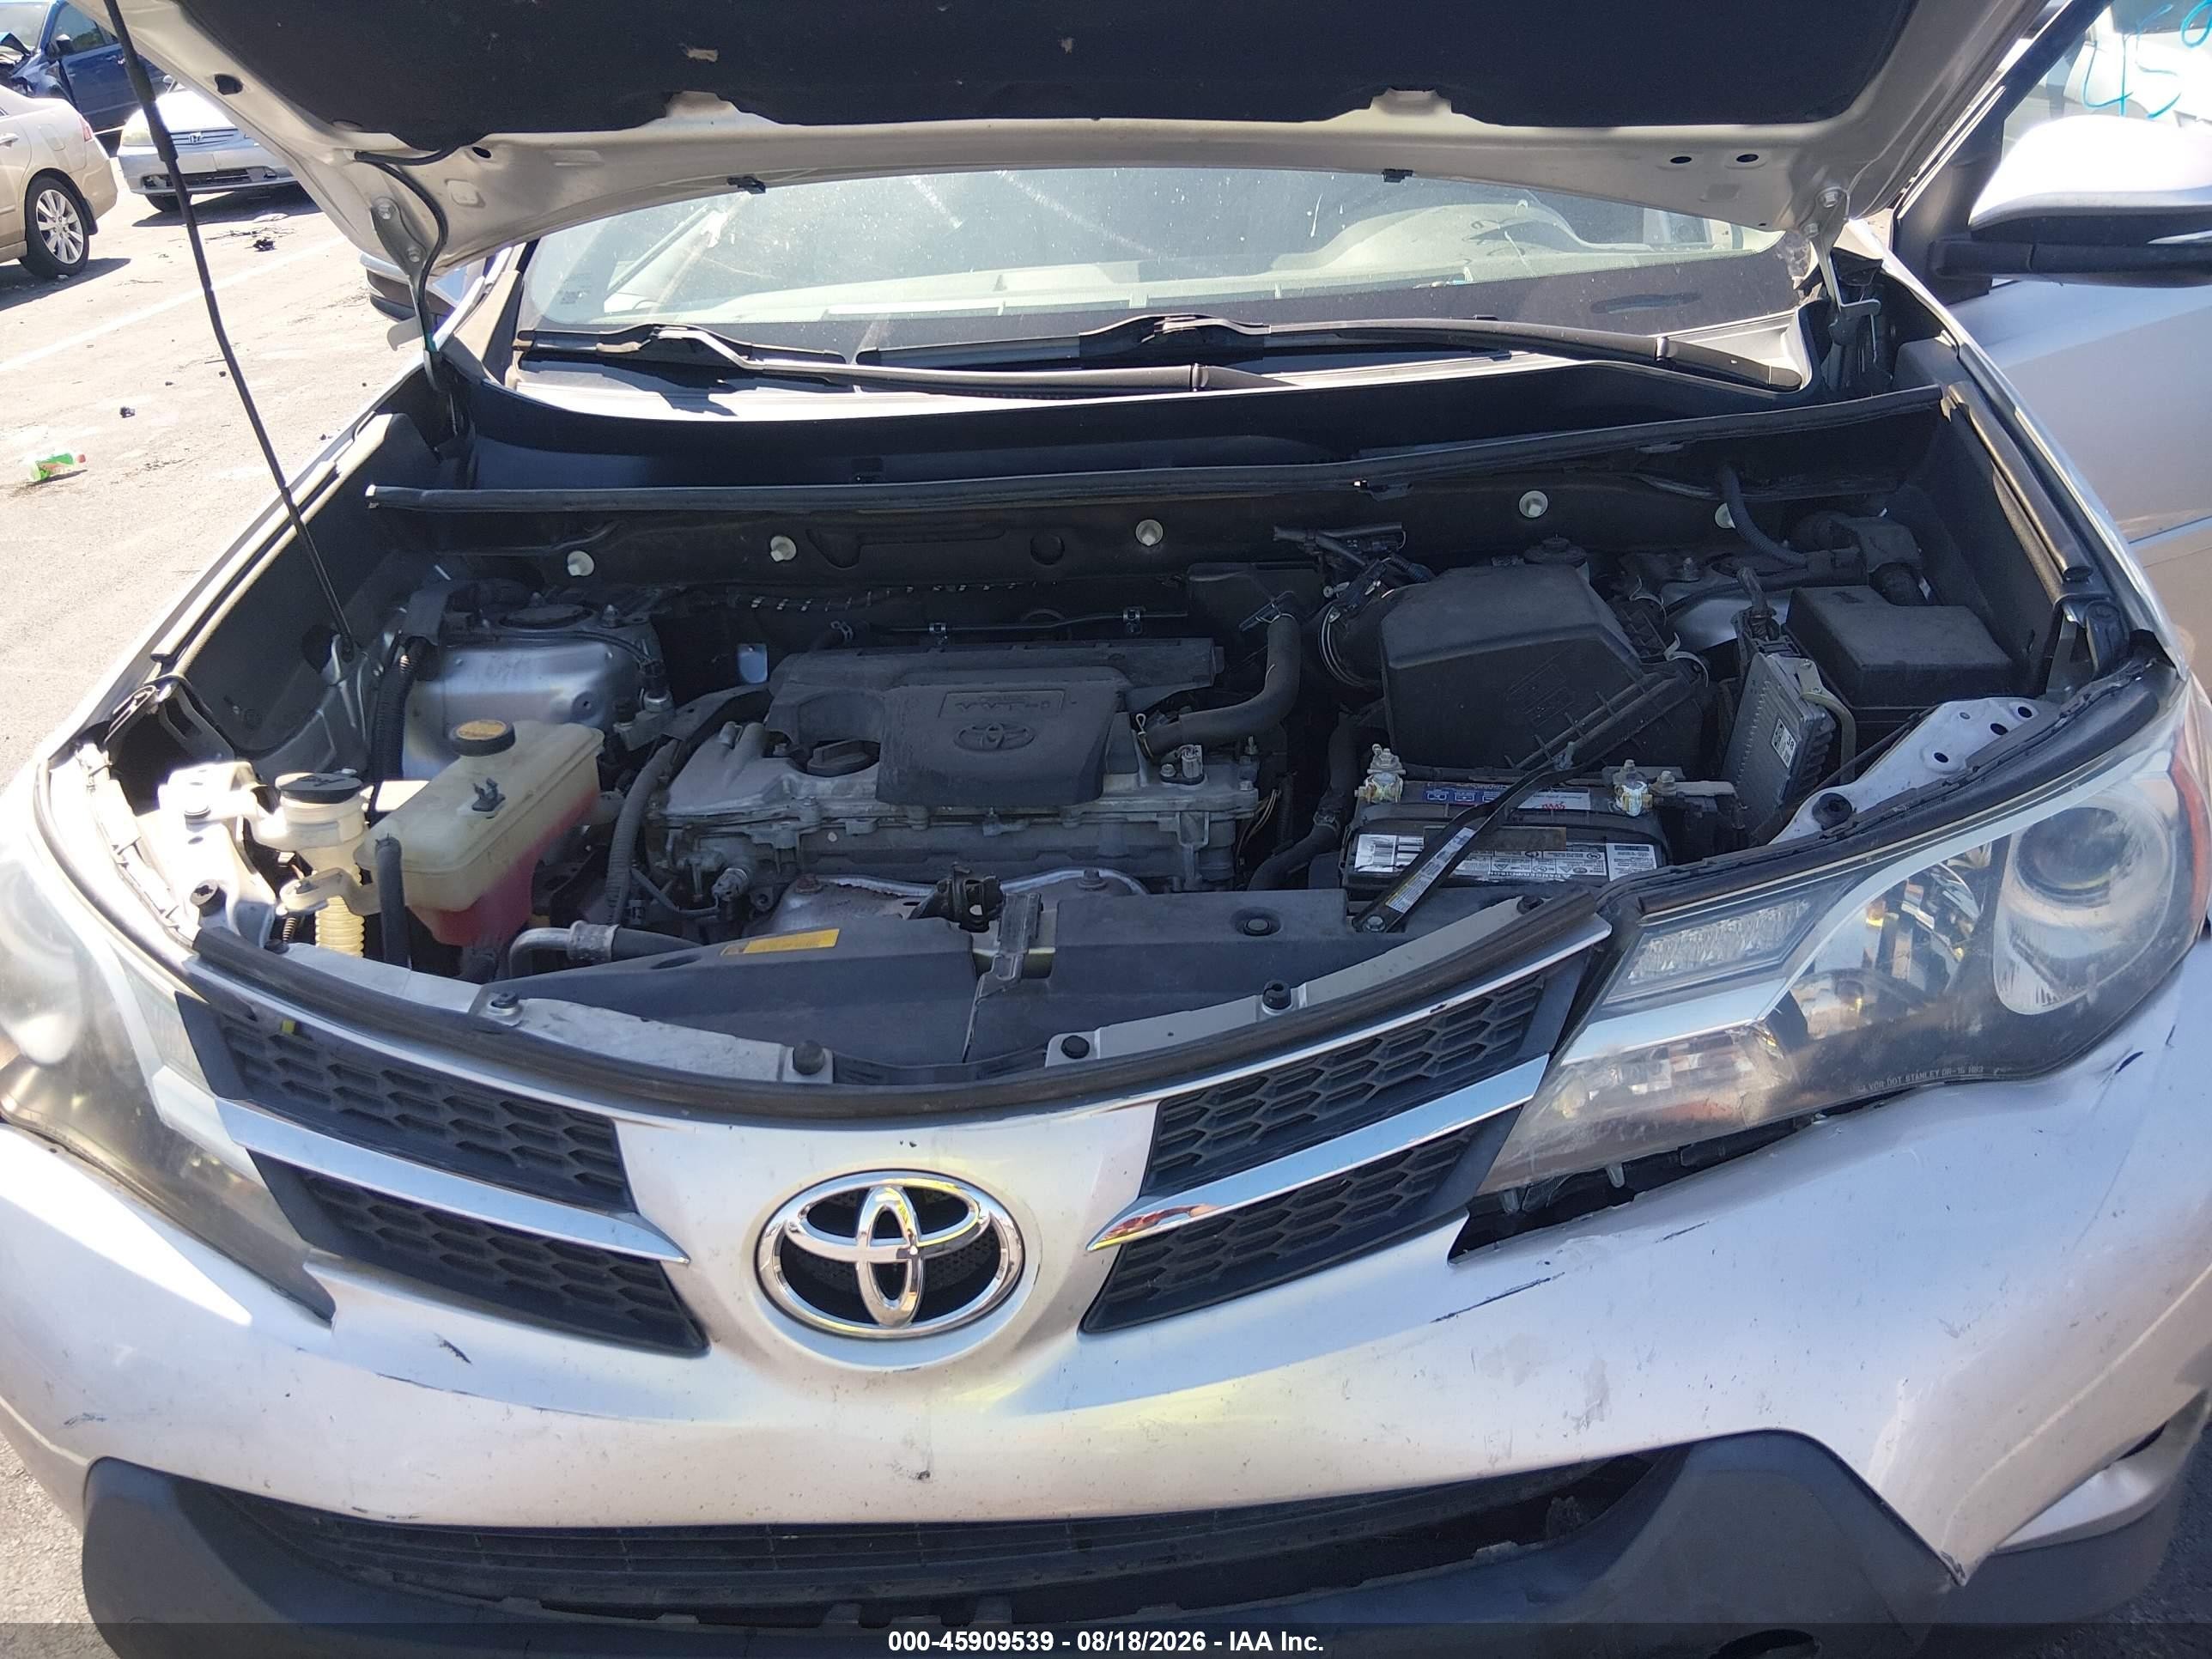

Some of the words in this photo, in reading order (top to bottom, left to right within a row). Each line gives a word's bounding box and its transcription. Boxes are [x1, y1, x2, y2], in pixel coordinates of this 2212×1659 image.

[1786, 735, 1795, 750] 38
[1887, 1077, 1902, 1086] DOT
[1905, 1070, 1939, 1082] STANLEY
